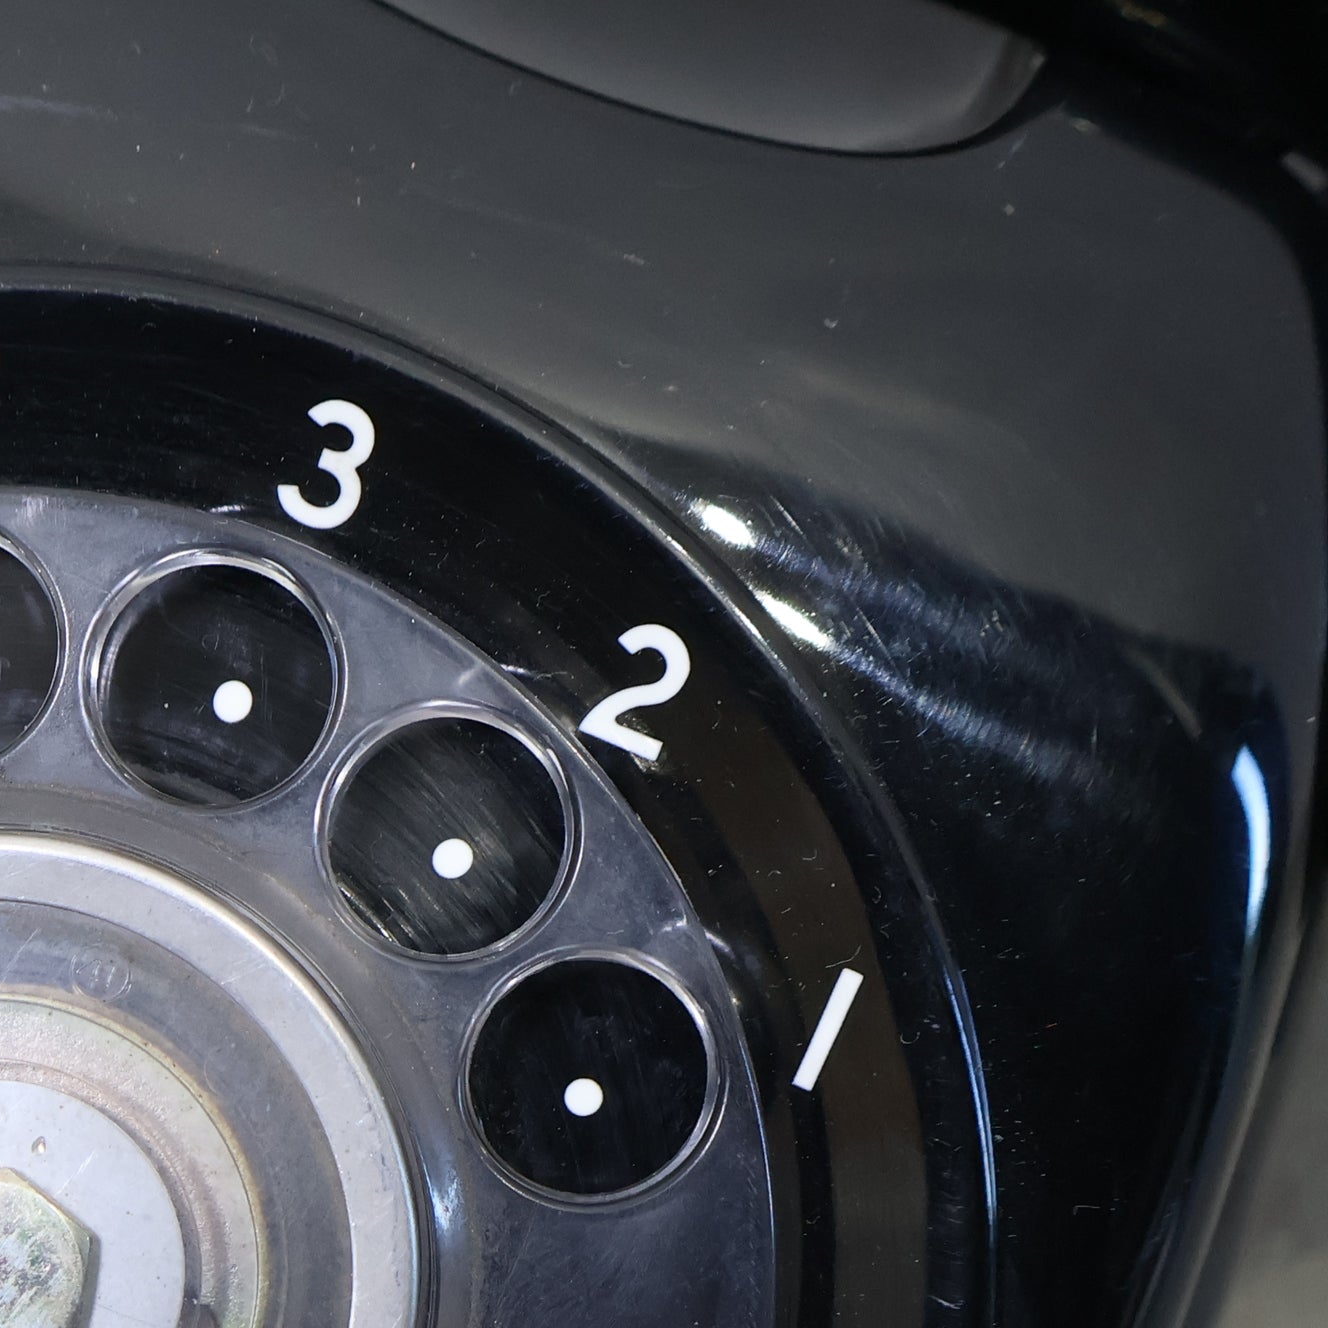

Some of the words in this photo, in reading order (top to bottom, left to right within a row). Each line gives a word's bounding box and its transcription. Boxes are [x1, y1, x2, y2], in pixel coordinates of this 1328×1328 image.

[277, 400, 375, 529] 3
[579, 624, 690, 761] 2
[793, 968, 863, 1090] 1
